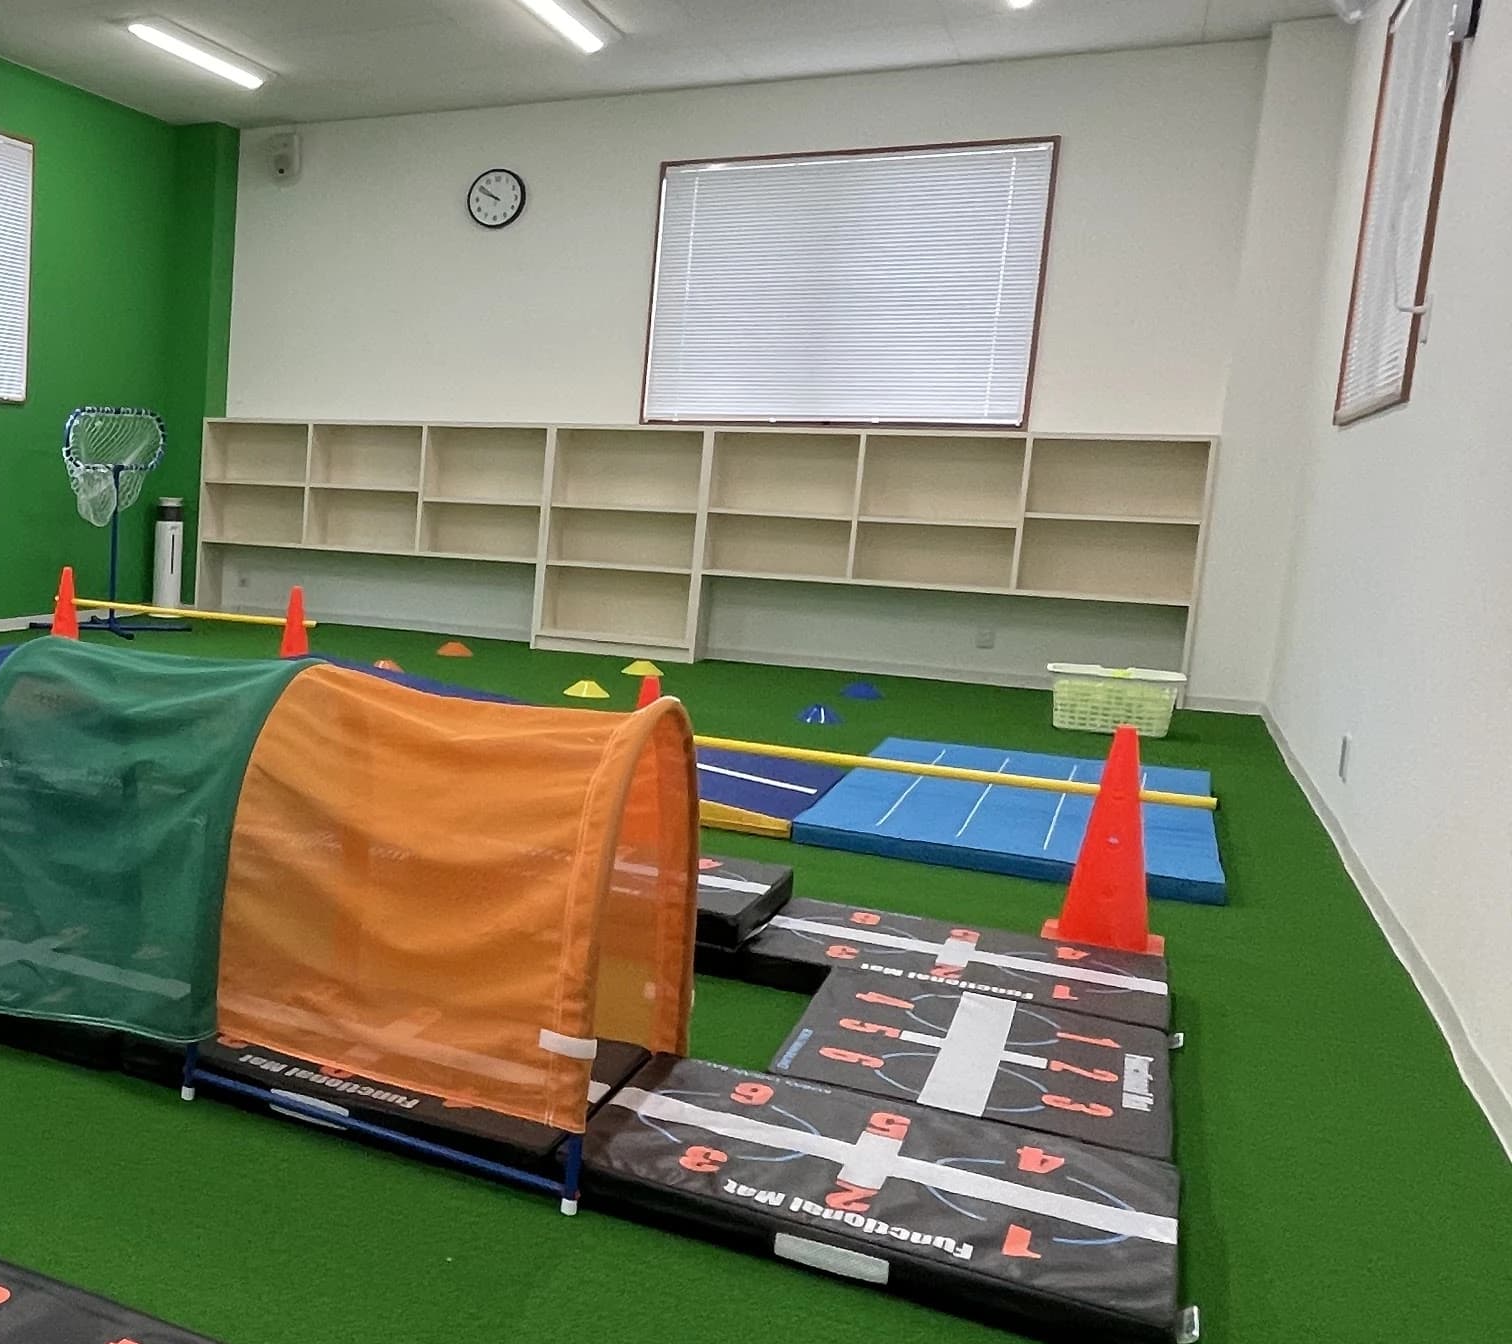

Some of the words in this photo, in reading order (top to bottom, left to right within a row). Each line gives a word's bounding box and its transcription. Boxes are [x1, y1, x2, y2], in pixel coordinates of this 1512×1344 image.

[1048, 1059, 1119, 1083] 2
[729, 1081, 776, 1106] 6
[1041, 1094, 1115, 1118] 3
[868, 1110, 912, 1141] 5
[679, 1144, 729, 1174] 3
[1016, 1145, 1066, 1174] 4
[722, 1178, 787, 1208] Mat
[825, 1179, 880, 1214] 2
[788, 1195, 974, 1261] Functional
[1001, 1223, 1043, 1259] 1
